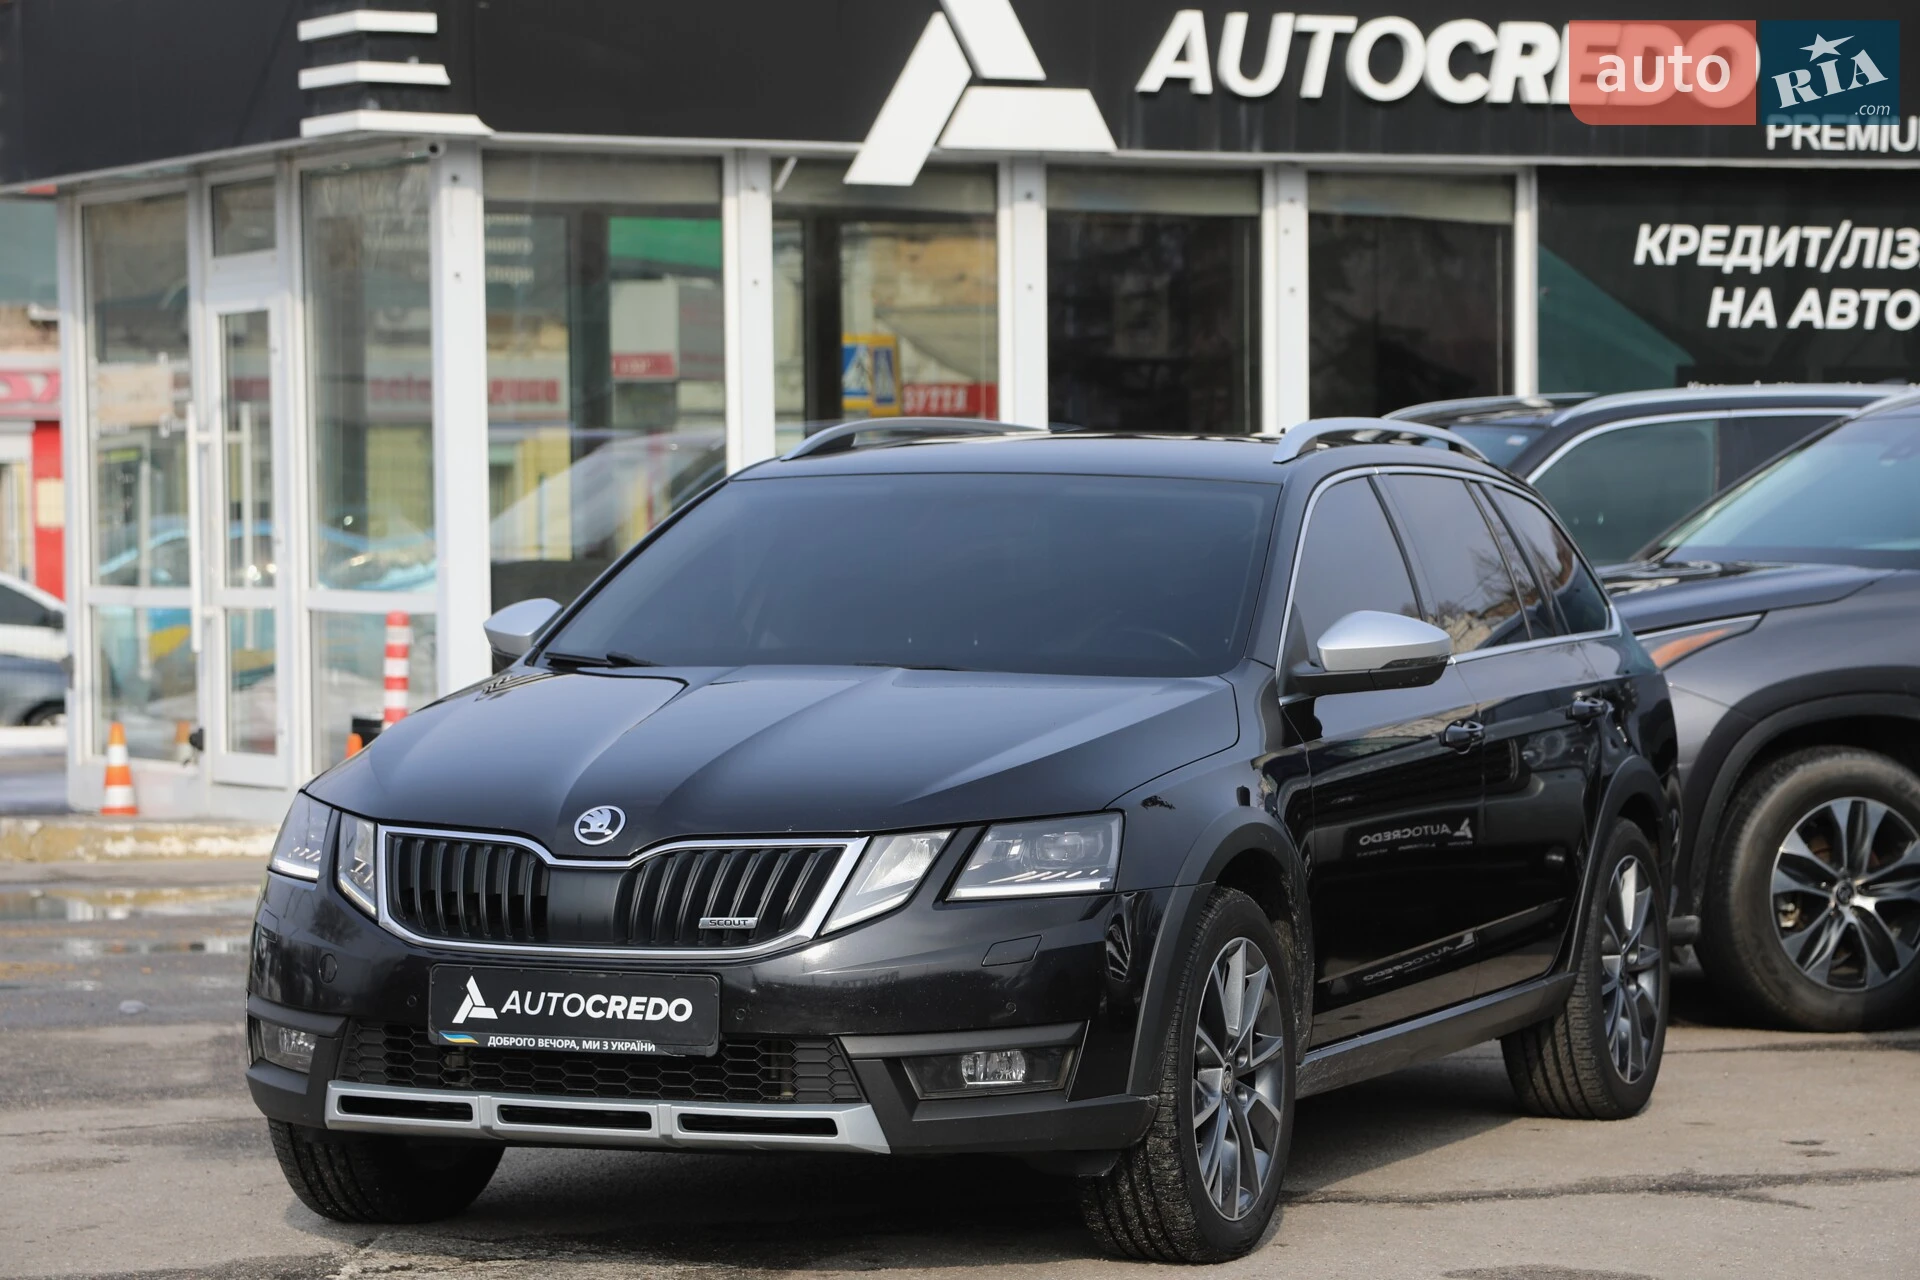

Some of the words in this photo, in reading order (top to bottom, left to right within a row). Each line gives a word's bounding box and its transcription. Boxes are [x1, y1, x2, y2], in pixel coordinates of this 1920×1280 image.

[1134, 9, 1762, 109] AUTOCREDO
[1766, 113, 1920, 153] PREMIU
[1633, 219, 1920, 275] КРЕДИТ/ЛІЗ
[1706, 286, 1778, 329] НА
[1786, 287, 1920, 331] АВТО
[709, 919, 748, 927] SCOUT
[500, 990, 693, 1022] AUTOCREDO
[487, 1035, 536, 1047] ДОБРОГО
[538, 1037, 579, 1050] ВЕЧОРА,
[582, 1039, 598, 1050] МИ
[611, 1040, 656, 1053] УКРАЇНИ
